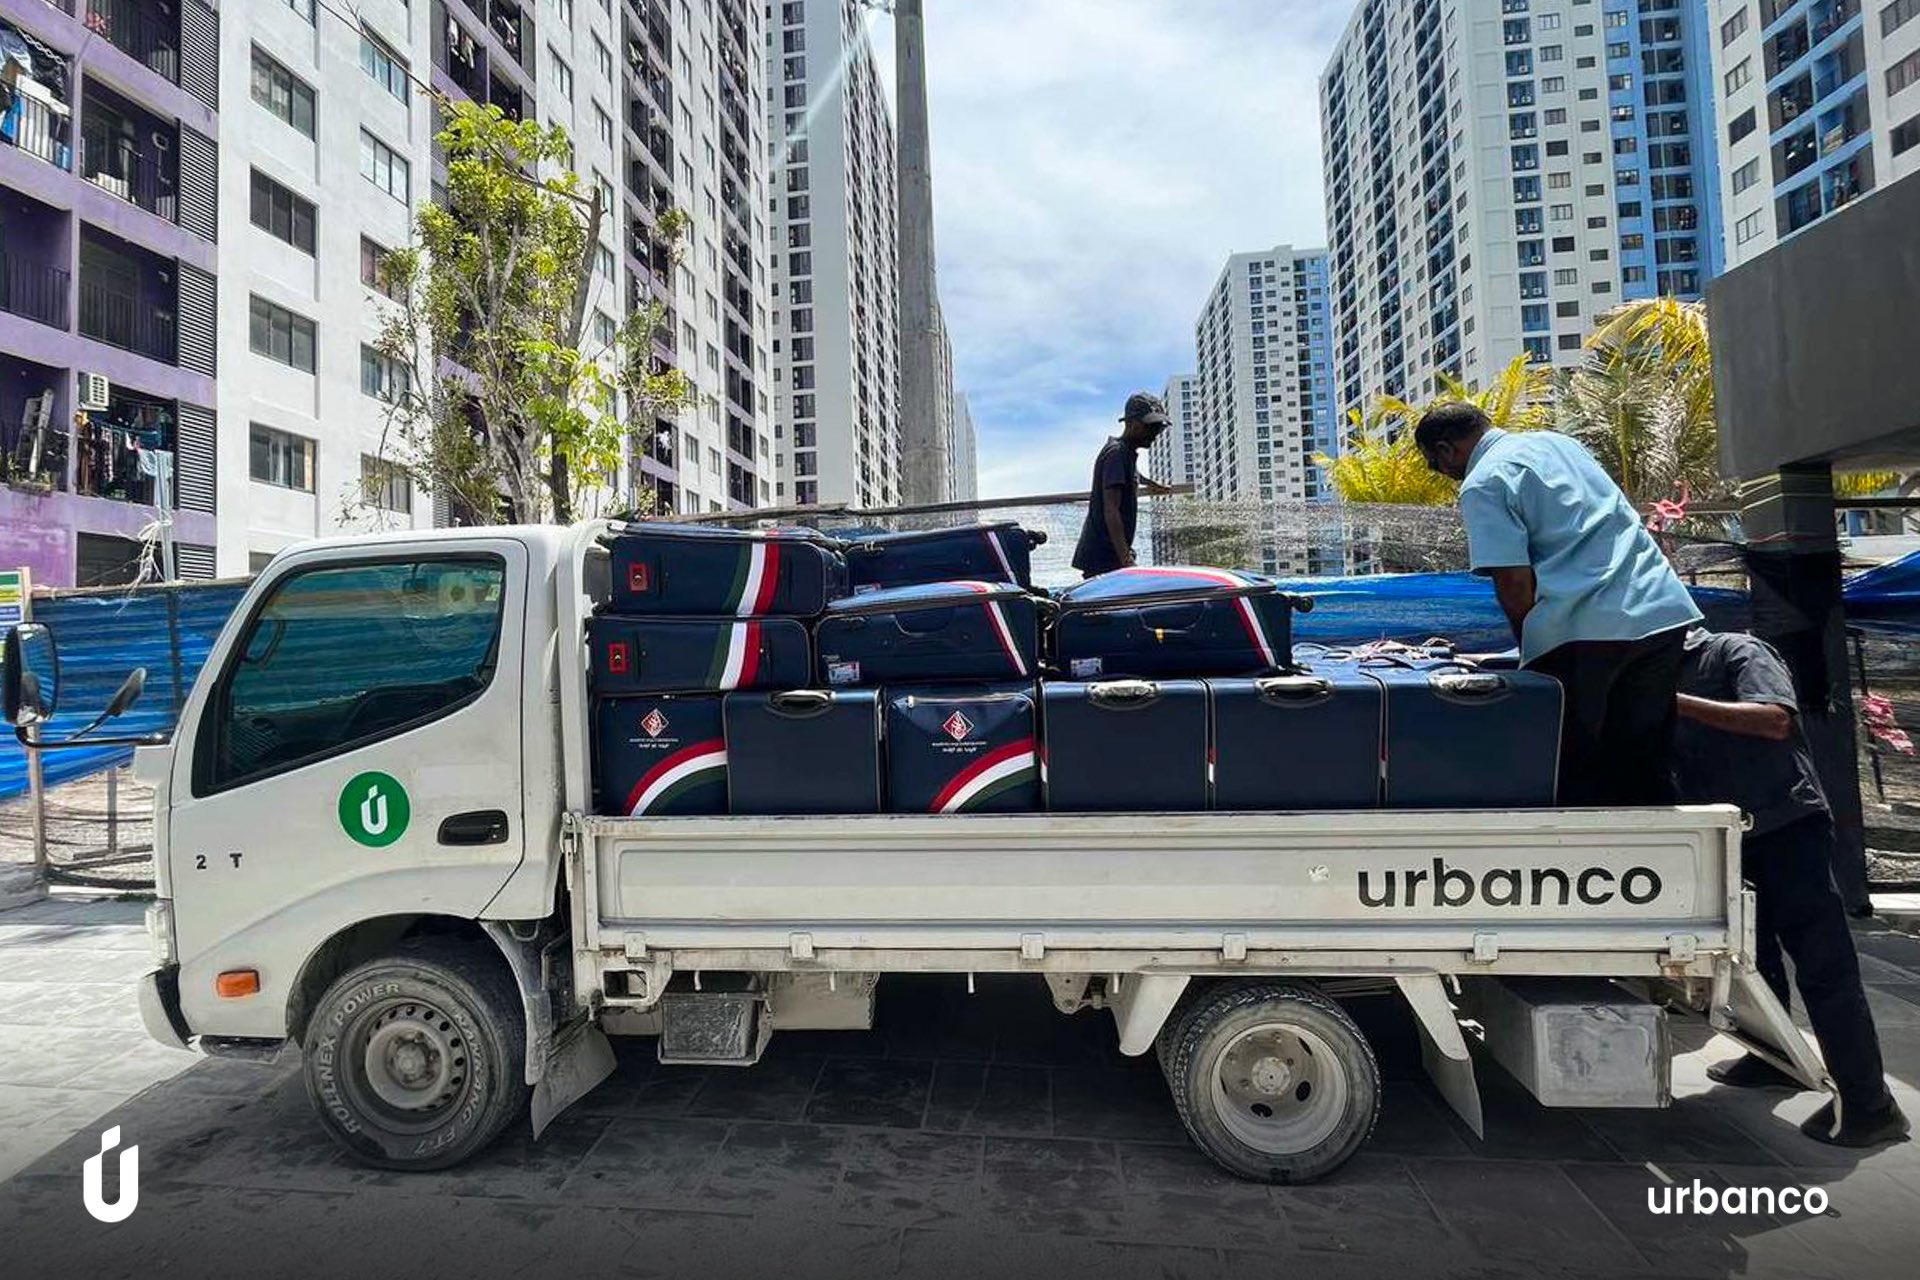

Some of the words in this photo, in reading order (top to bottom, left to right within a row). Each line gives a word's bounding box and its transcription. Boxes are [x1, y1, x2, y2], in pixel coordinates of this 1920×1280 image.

[196, 854, 208, 869] 2
[229, 853, 243, 868] T
[1358, 857, 1663, 907] urbanco
[334, 983, 400, 1026] POWER
